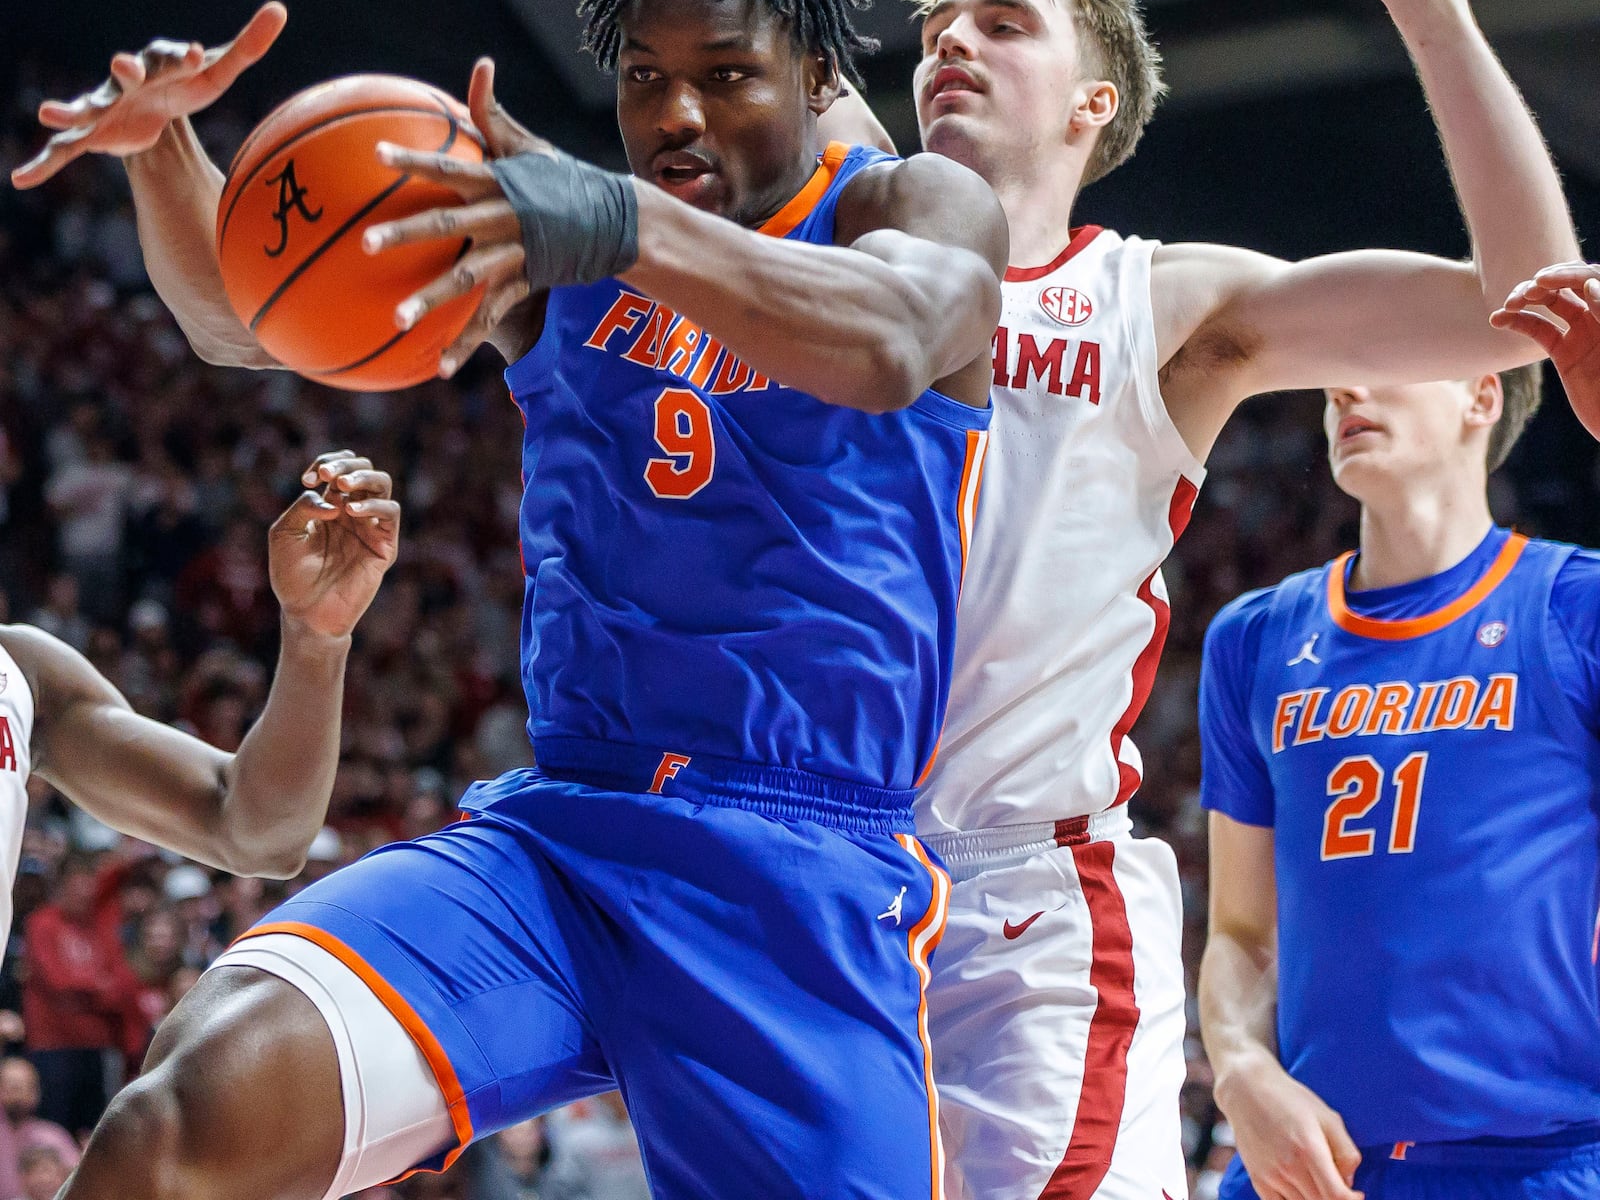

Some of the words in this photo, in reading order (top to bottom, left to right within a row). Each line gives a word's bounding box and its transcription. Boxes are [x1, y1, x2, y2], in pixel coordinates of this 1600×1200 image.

[264, 159, 323, 257] A
[1040, 286, 1093, 324] SEC
[643, 387, 716, 499] 9
[1272, 673, 1518, 754] FLORIDA
[646, 752, 692, 794] F
[1320, 751, 1429, 862] 21
